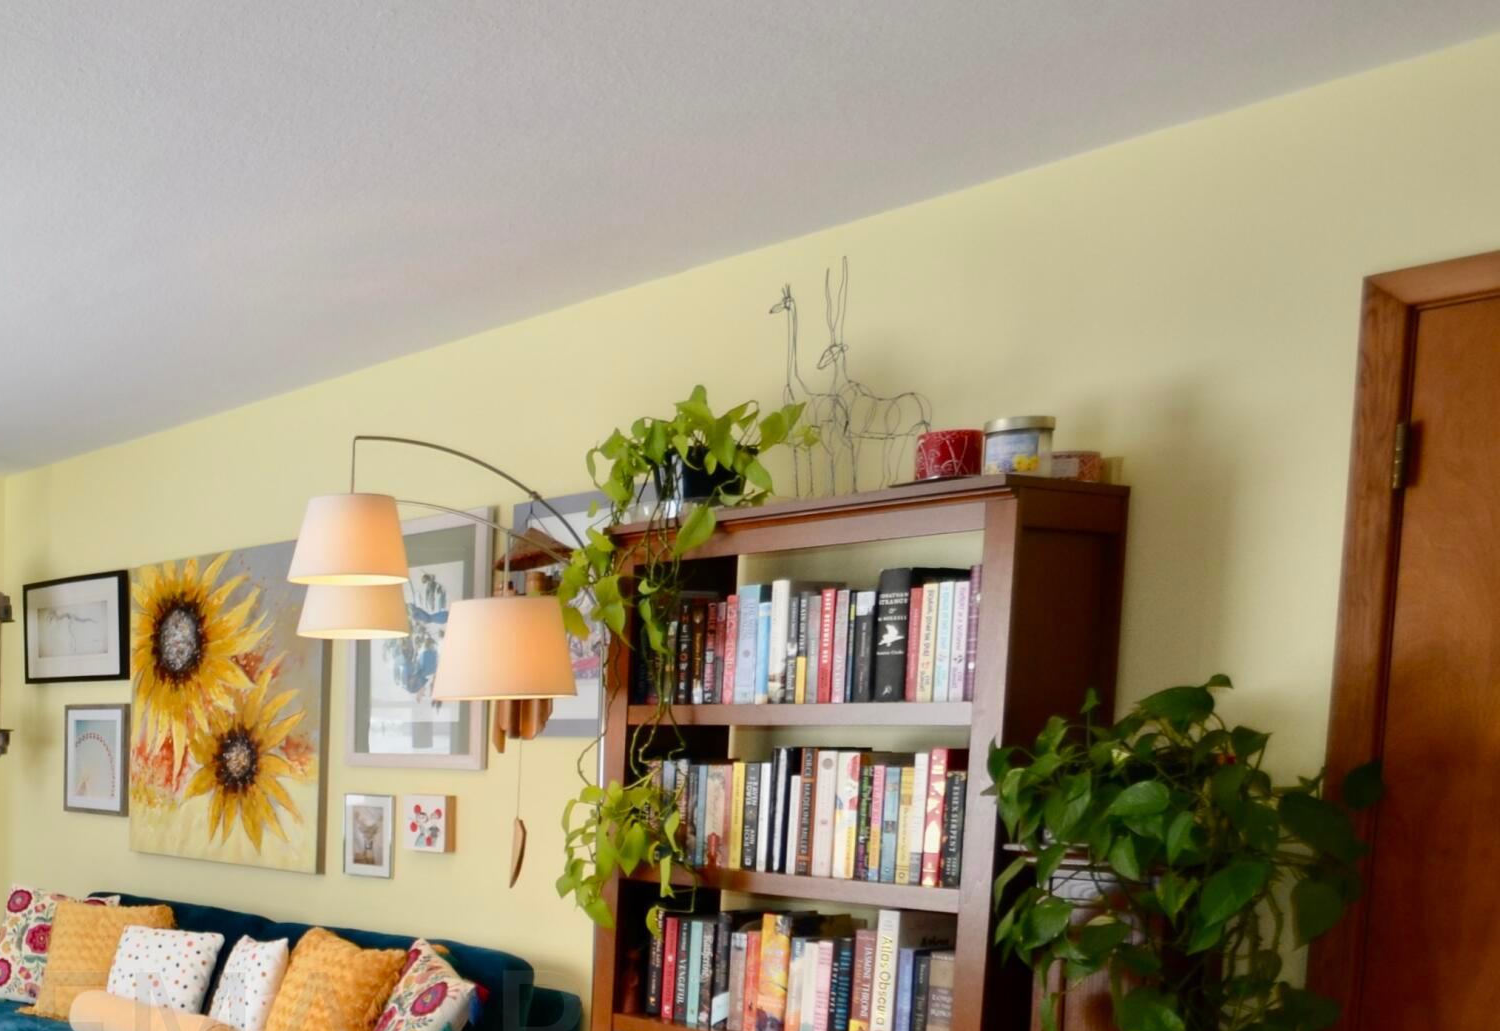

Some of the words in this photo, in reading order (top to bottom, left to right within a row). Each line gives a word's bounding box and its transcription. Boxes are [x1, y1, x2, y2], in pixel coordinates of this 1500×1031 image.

[786, 659, 796, 690] Kindred
[803, 752, 813, 777] CIRCE
[802, 783, 811, 825] MADELINE
[952, 786, 961, 813] ESSEX
[801, 827, 809, 854] MILLER
[949, 814, 960, 852] SERPENT
[863, 947, 873, 978] JASMINE
[880, 936, 893, 968] Atlas
[677, 959, 687, 1005] VENGEFUL
[875, 970, 891, 1026] Obscura
